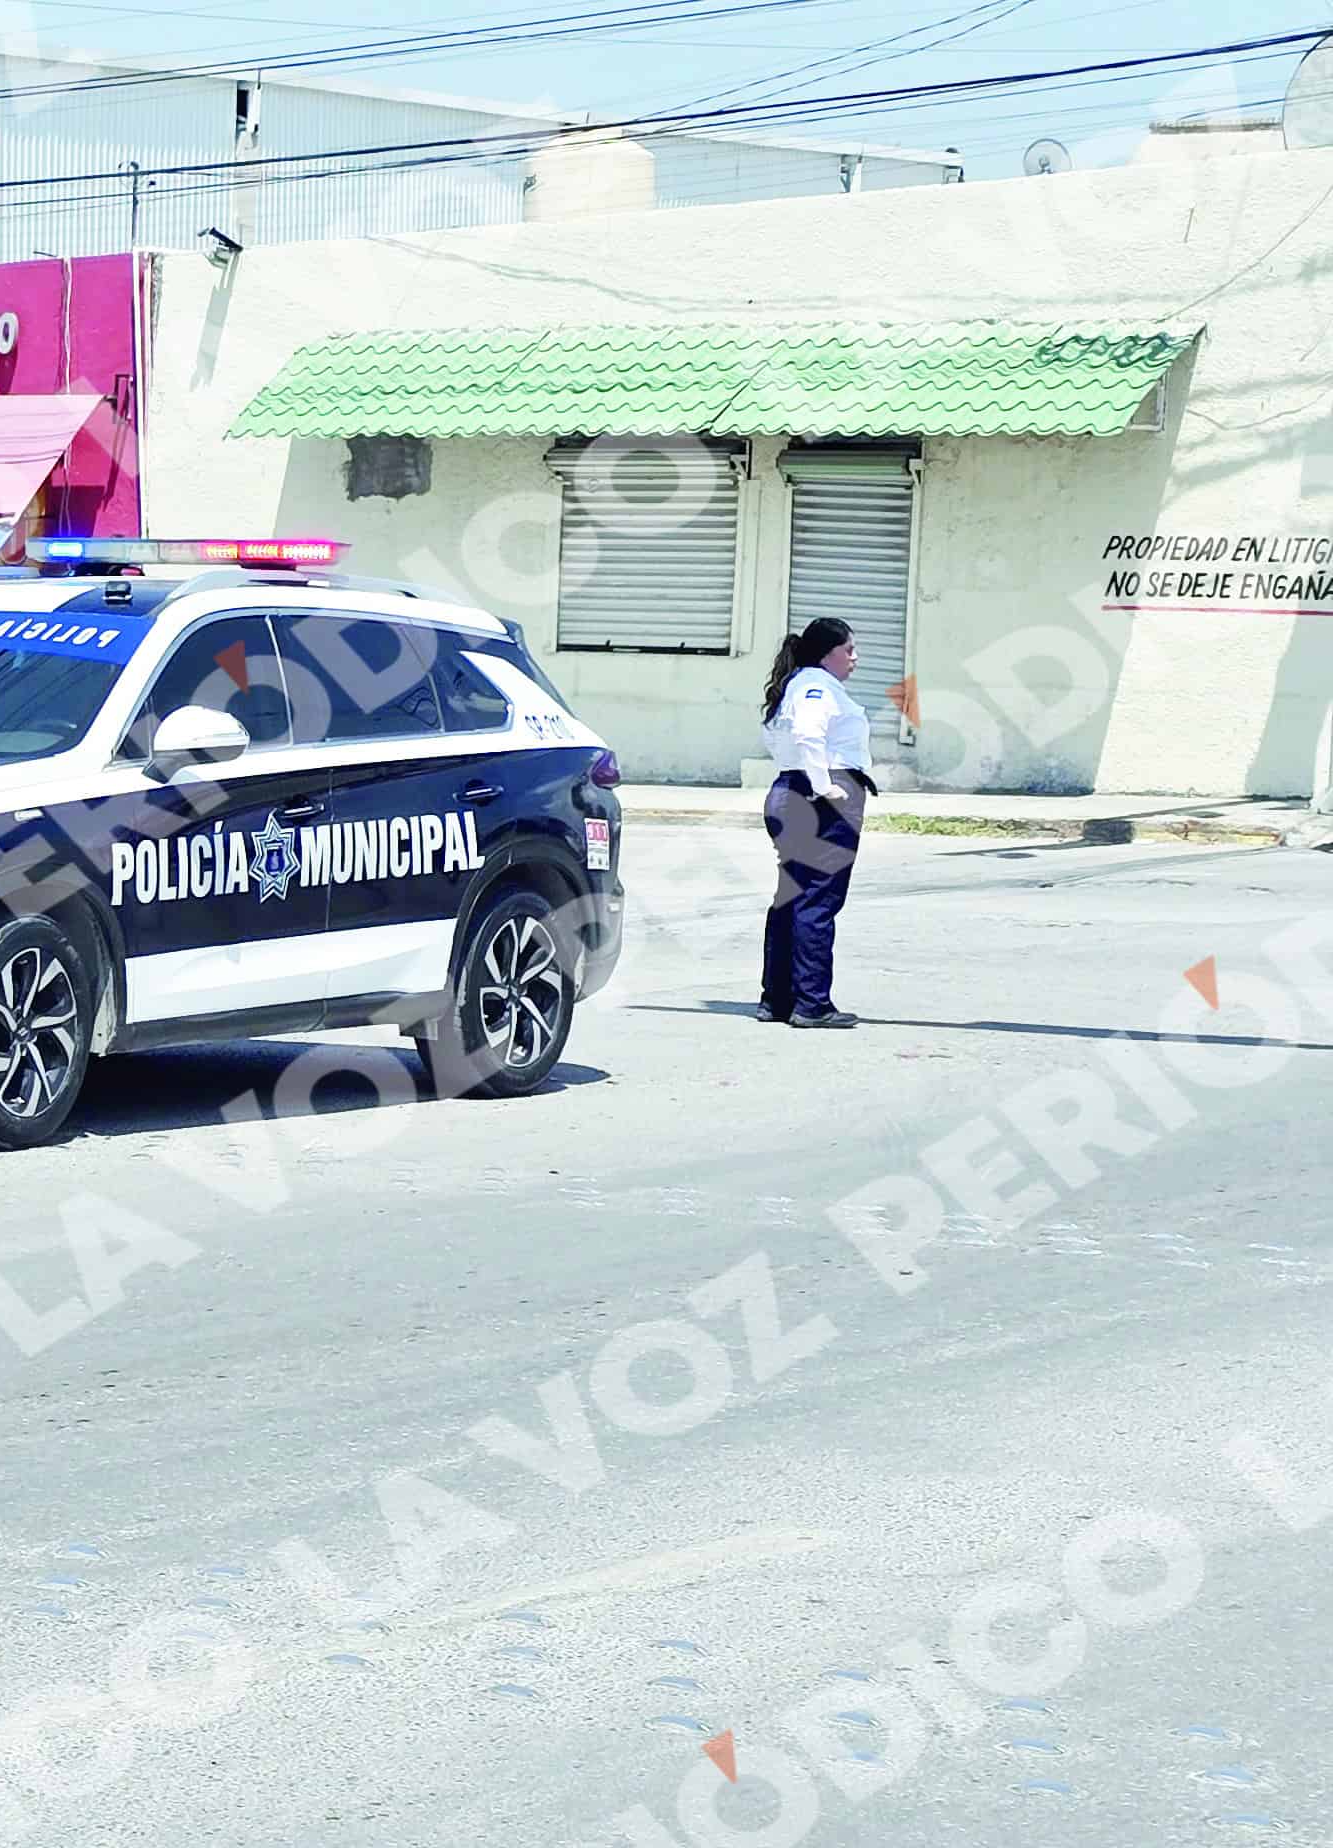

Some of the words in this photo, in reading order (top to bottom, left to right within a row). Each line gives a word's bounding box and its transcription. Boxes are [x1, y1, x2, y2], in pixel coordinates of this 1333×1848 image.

[1102, 535, 1229, 561] PROPIEDAD
[1231, 536, 1267, 562] EN
[1104, 570, 1141, 598] NO
[1145, 571, 1175, 598] SE
[1176, 572, 1234, 599] DEJE
[111, 820, 249, 907] POLICÍA
[299, 810, 486, 888] MUNICIPAL
